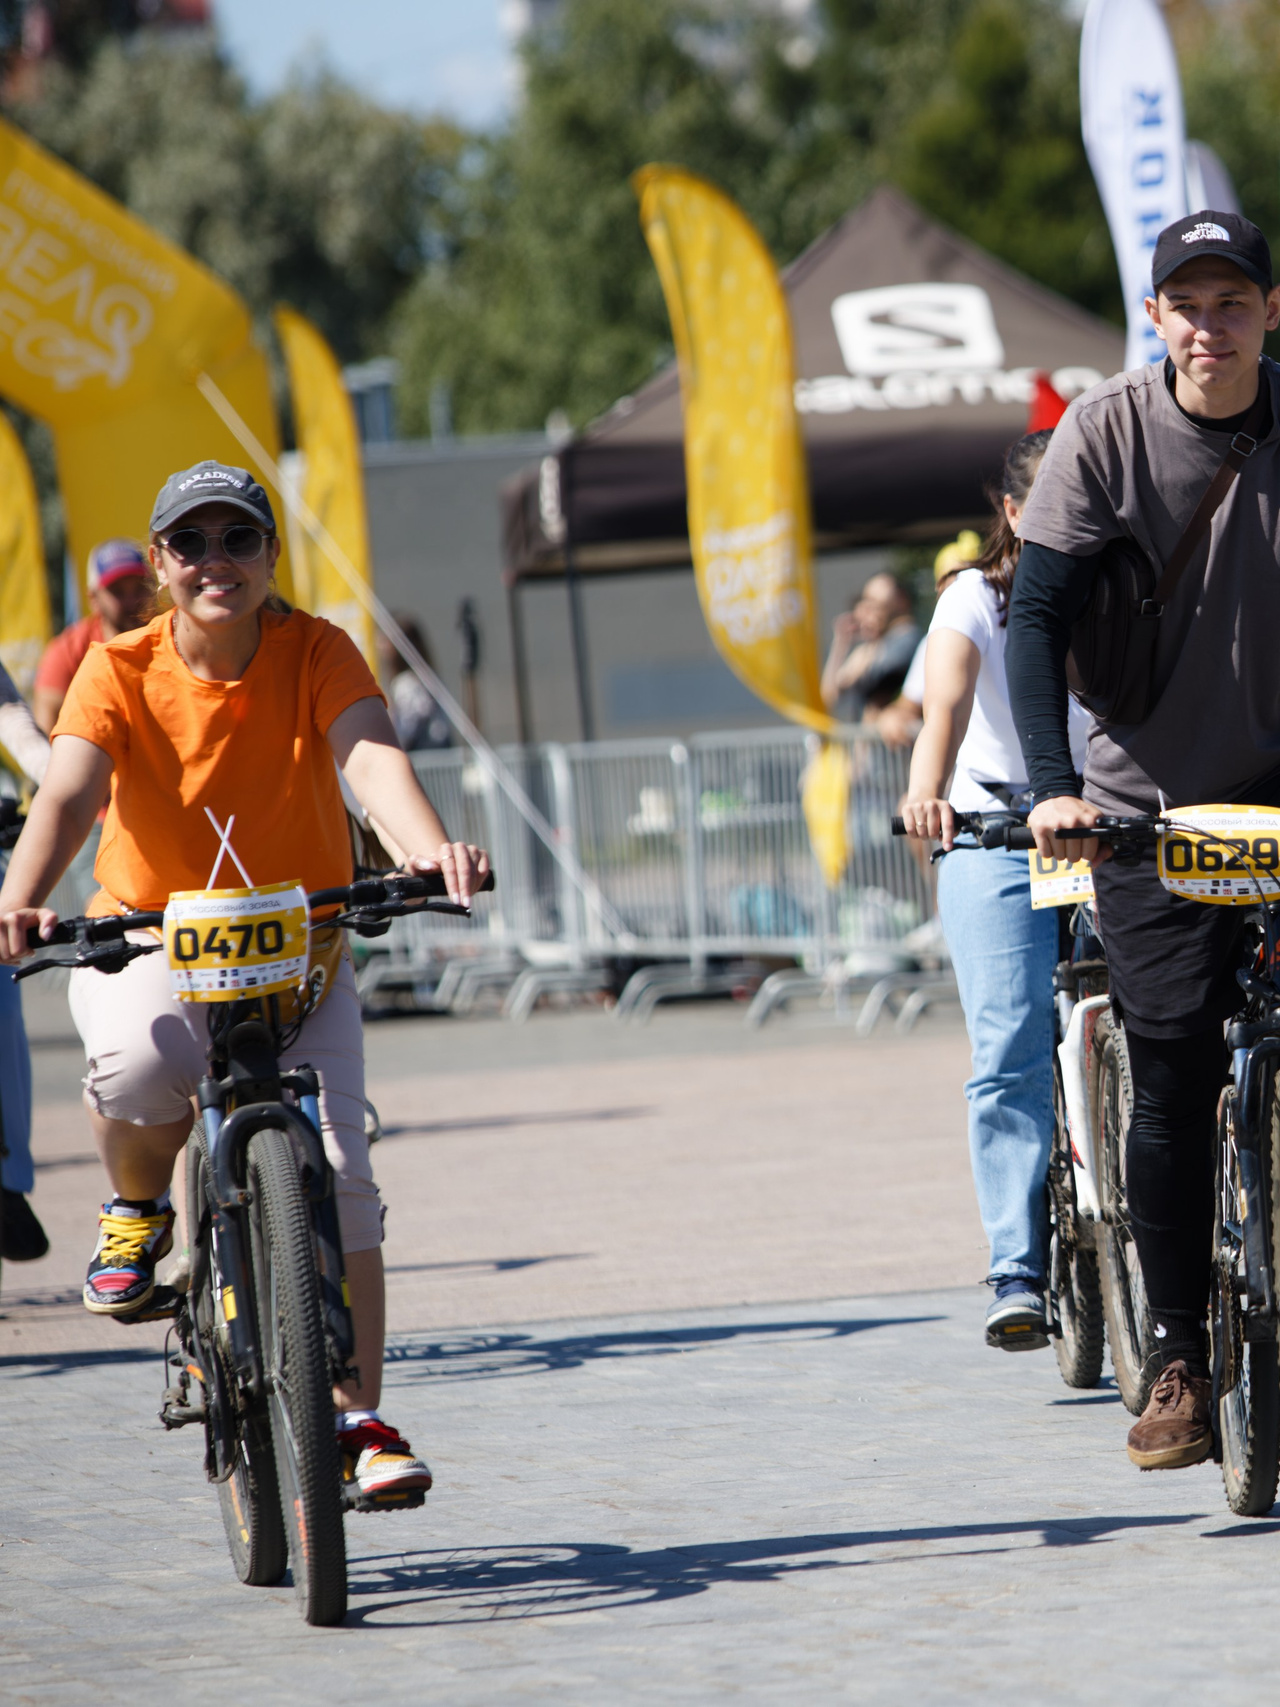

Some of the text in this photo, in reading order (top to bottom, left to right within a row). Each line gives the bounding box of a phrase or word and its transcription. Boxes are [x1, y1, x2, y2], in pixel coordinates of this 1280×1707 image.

[1194, 222, 1213, 231] THE
[1181, 229, 1214, 241] NORTH
[178, 471, 244, 492] PARADISE
[1244, 818, 1279, 828] заезд
[1165, 838, 1280, 872] 0629
[248, 900, 282, 910] заезд
[174, 920, 284, 962] 0470
